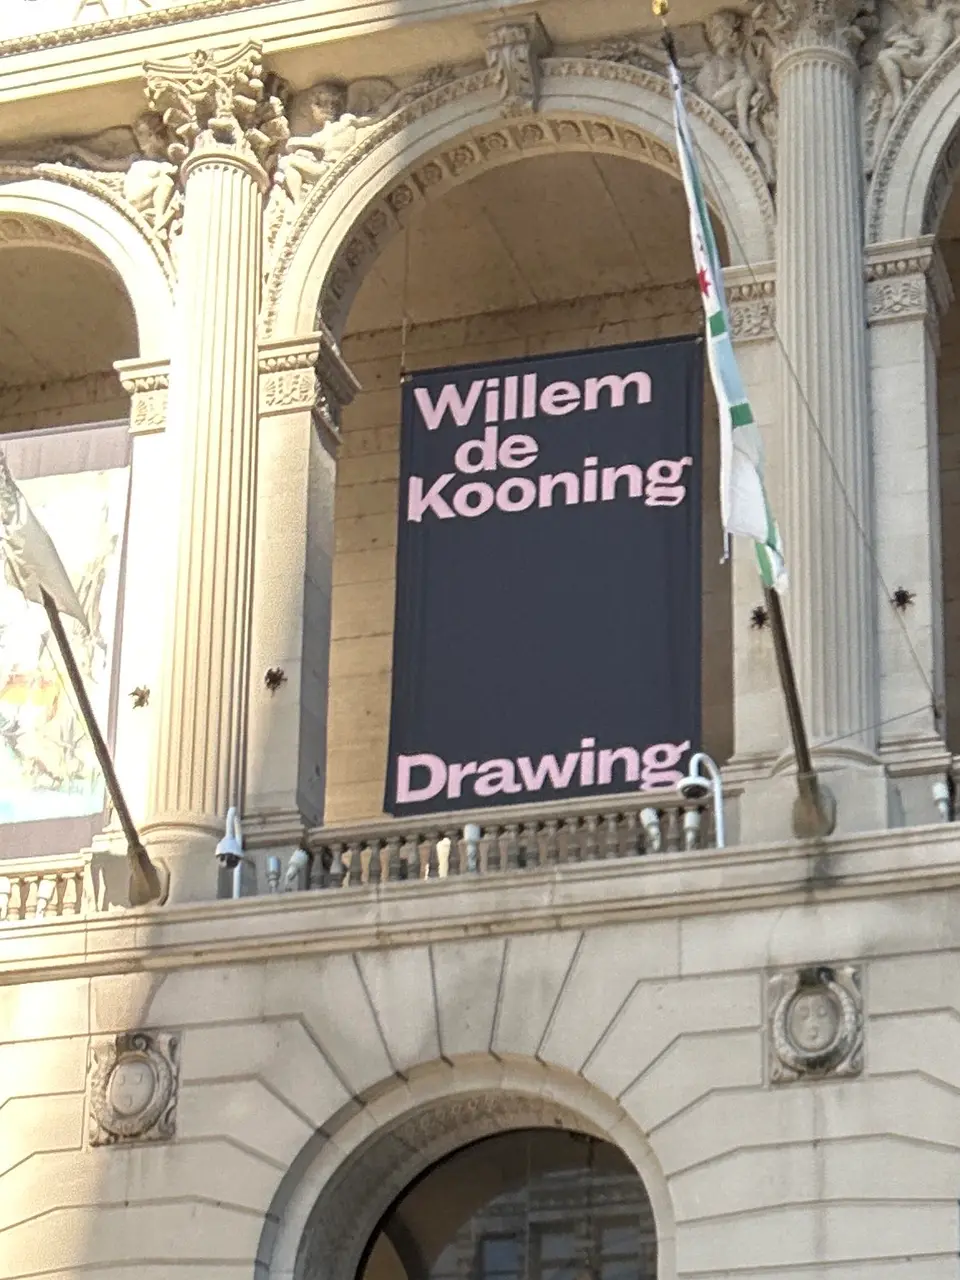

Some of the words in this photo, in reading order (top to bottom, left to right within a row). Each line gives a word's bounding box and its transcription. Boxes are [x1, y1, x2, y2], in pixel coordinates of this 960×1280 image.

[414, 372, 653, 430] Willem
[455, 426, 539, 473] de
[407, 456, 693, 523] Kooning
[395, 738, 691, 804] Drawing
